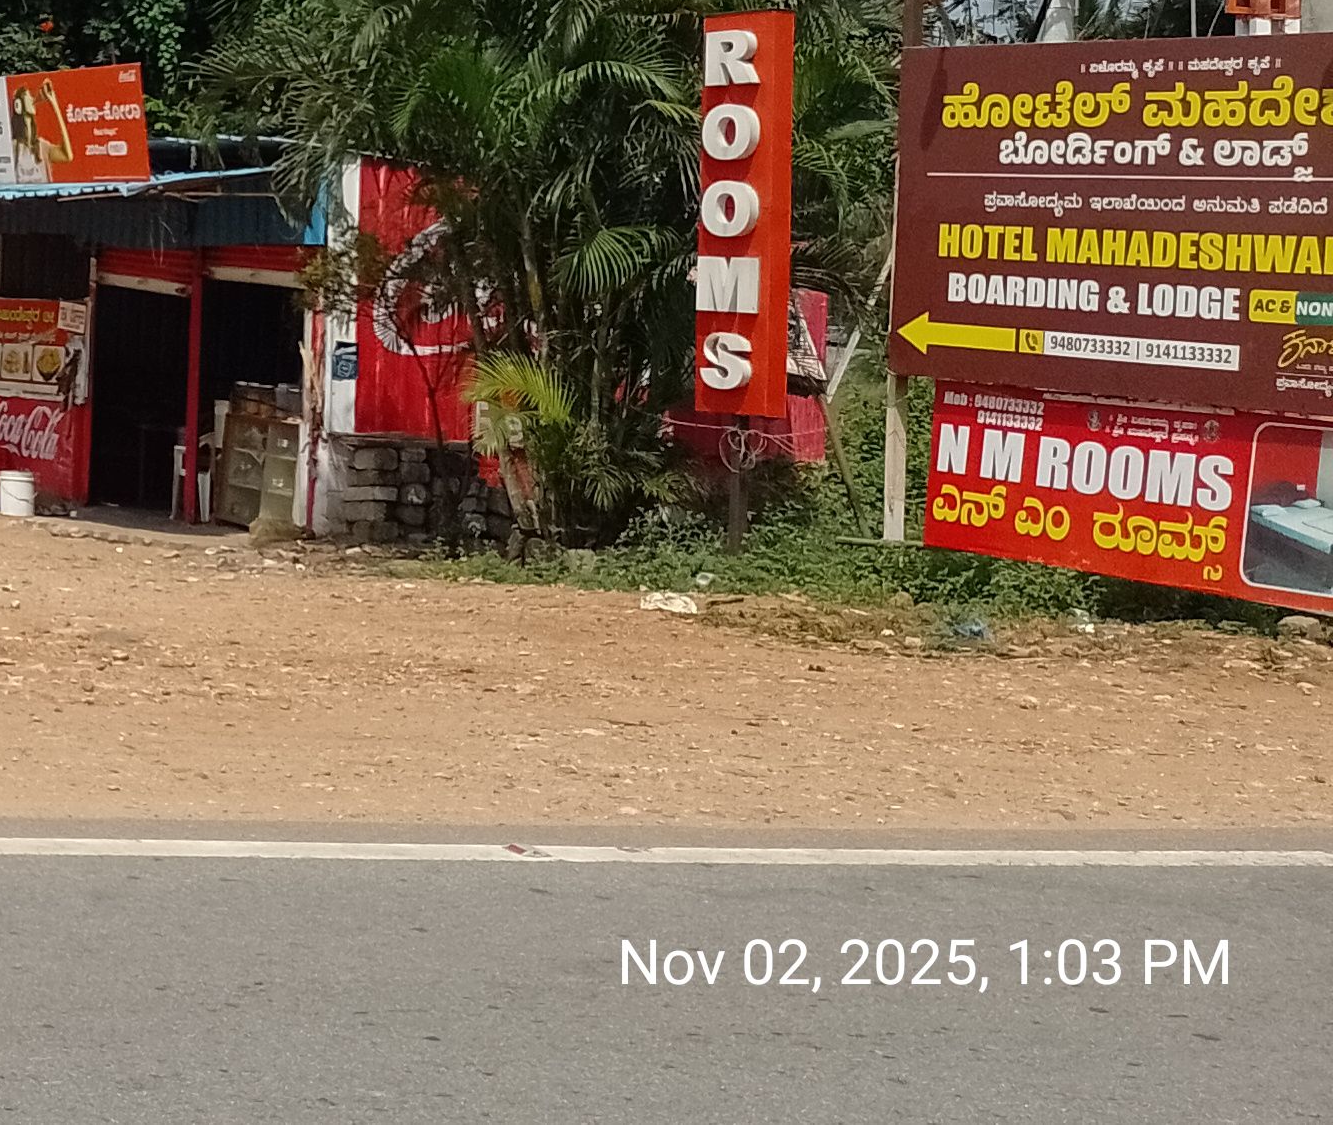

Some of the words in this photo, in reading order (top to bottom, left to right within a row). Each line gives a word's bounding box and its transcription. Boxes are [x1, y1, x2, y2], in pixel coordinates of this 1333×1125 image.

[940, 78, 1132, 129] ಹೋಟೆಲ್
[1141, 74, 1333, 128] ಮಹದೇ
[998, 131, 1172, 166] ಬೋರ್ಡಿಂಗ್
[1178, 136, 1206, 167] &
[1212, 131, 1313, 183] ಲಾಡ್ಜ್
[695, 29, 761, 390] ROOMS
[983, 189, 1083, 219] ಪ್ರವಾಸೋದ್ಯಮ
[1089, 192, 1186, 214] ಇಲಾಖೆಯಿಂದ
[1192, 194, 1260, 215] ಅನುಮತಿ
[937, 221, 1038, 262] HOTEL
[1045, 226, 1333, 276] MAHADESHWA
[947, 271, 1100, 312] BOARDING
[1106, 285, 1131, 315] &
[1136, 282, 1241, 321] LODGE
[1253, 298, 1277, 314] AC
[1279, 299, 1292, 315] &
[1049, 334, 1131, 357] 9480733332
[1145, 342, 1233, 365] 9141133332
[943, 391, 969, 407] Mob
[974, 395, 1045, 415] 9480733332
[976, 411, 1044, 432] 9141133332
[936, 422, 970, 475] N
[979, 429, 1026, 483] M
[1035, 435, 1235, 511] ROOMS
[932, 482, 1007, 528] ಎನ್
[1014, 496, 1071, 542] ಎಂ
[1091, 503, 1228, 581] ರೂಮ್ಸ್
